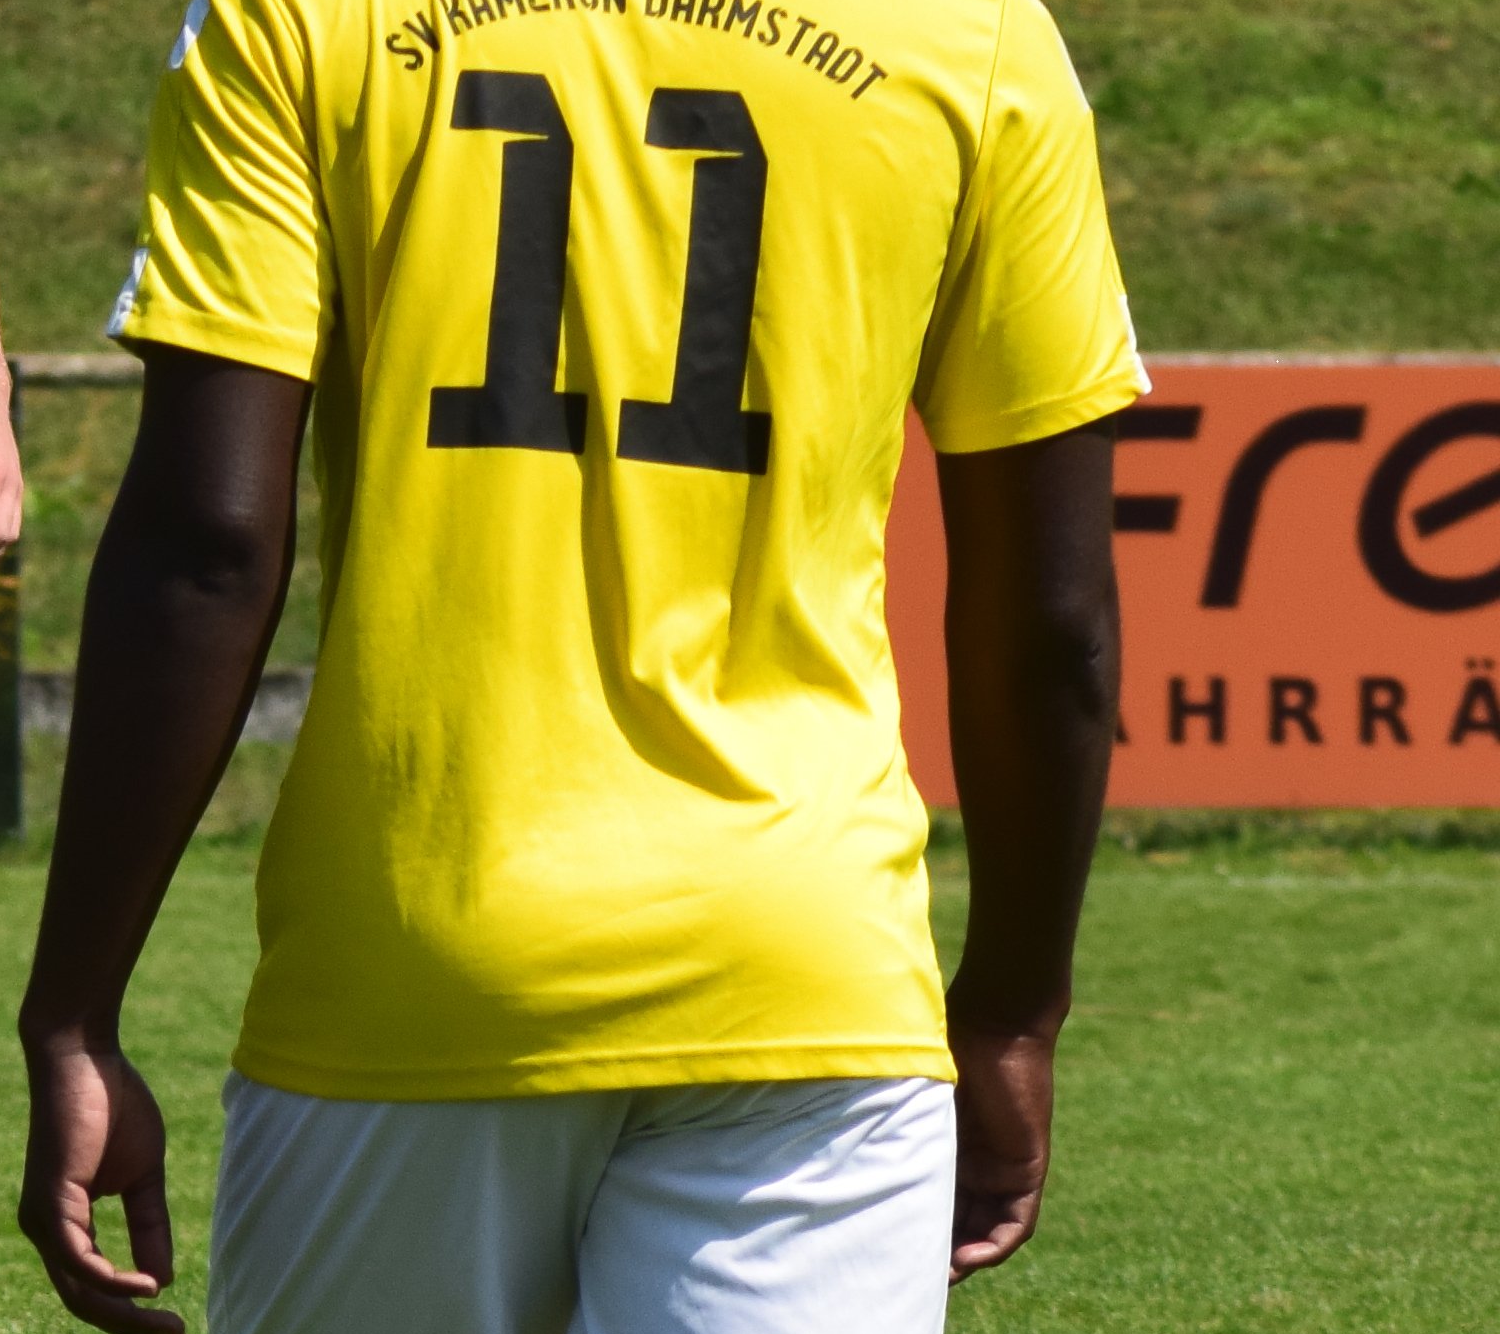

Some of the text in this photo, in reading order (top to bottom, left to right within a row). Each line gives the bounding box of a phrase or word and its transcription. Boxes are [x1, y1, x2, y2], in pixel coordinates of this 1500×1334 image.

[386, 11, 441, 71] SV
[426, 68, 772, 476] 11
[1115, 658, 1500, 746] HRRÄ
